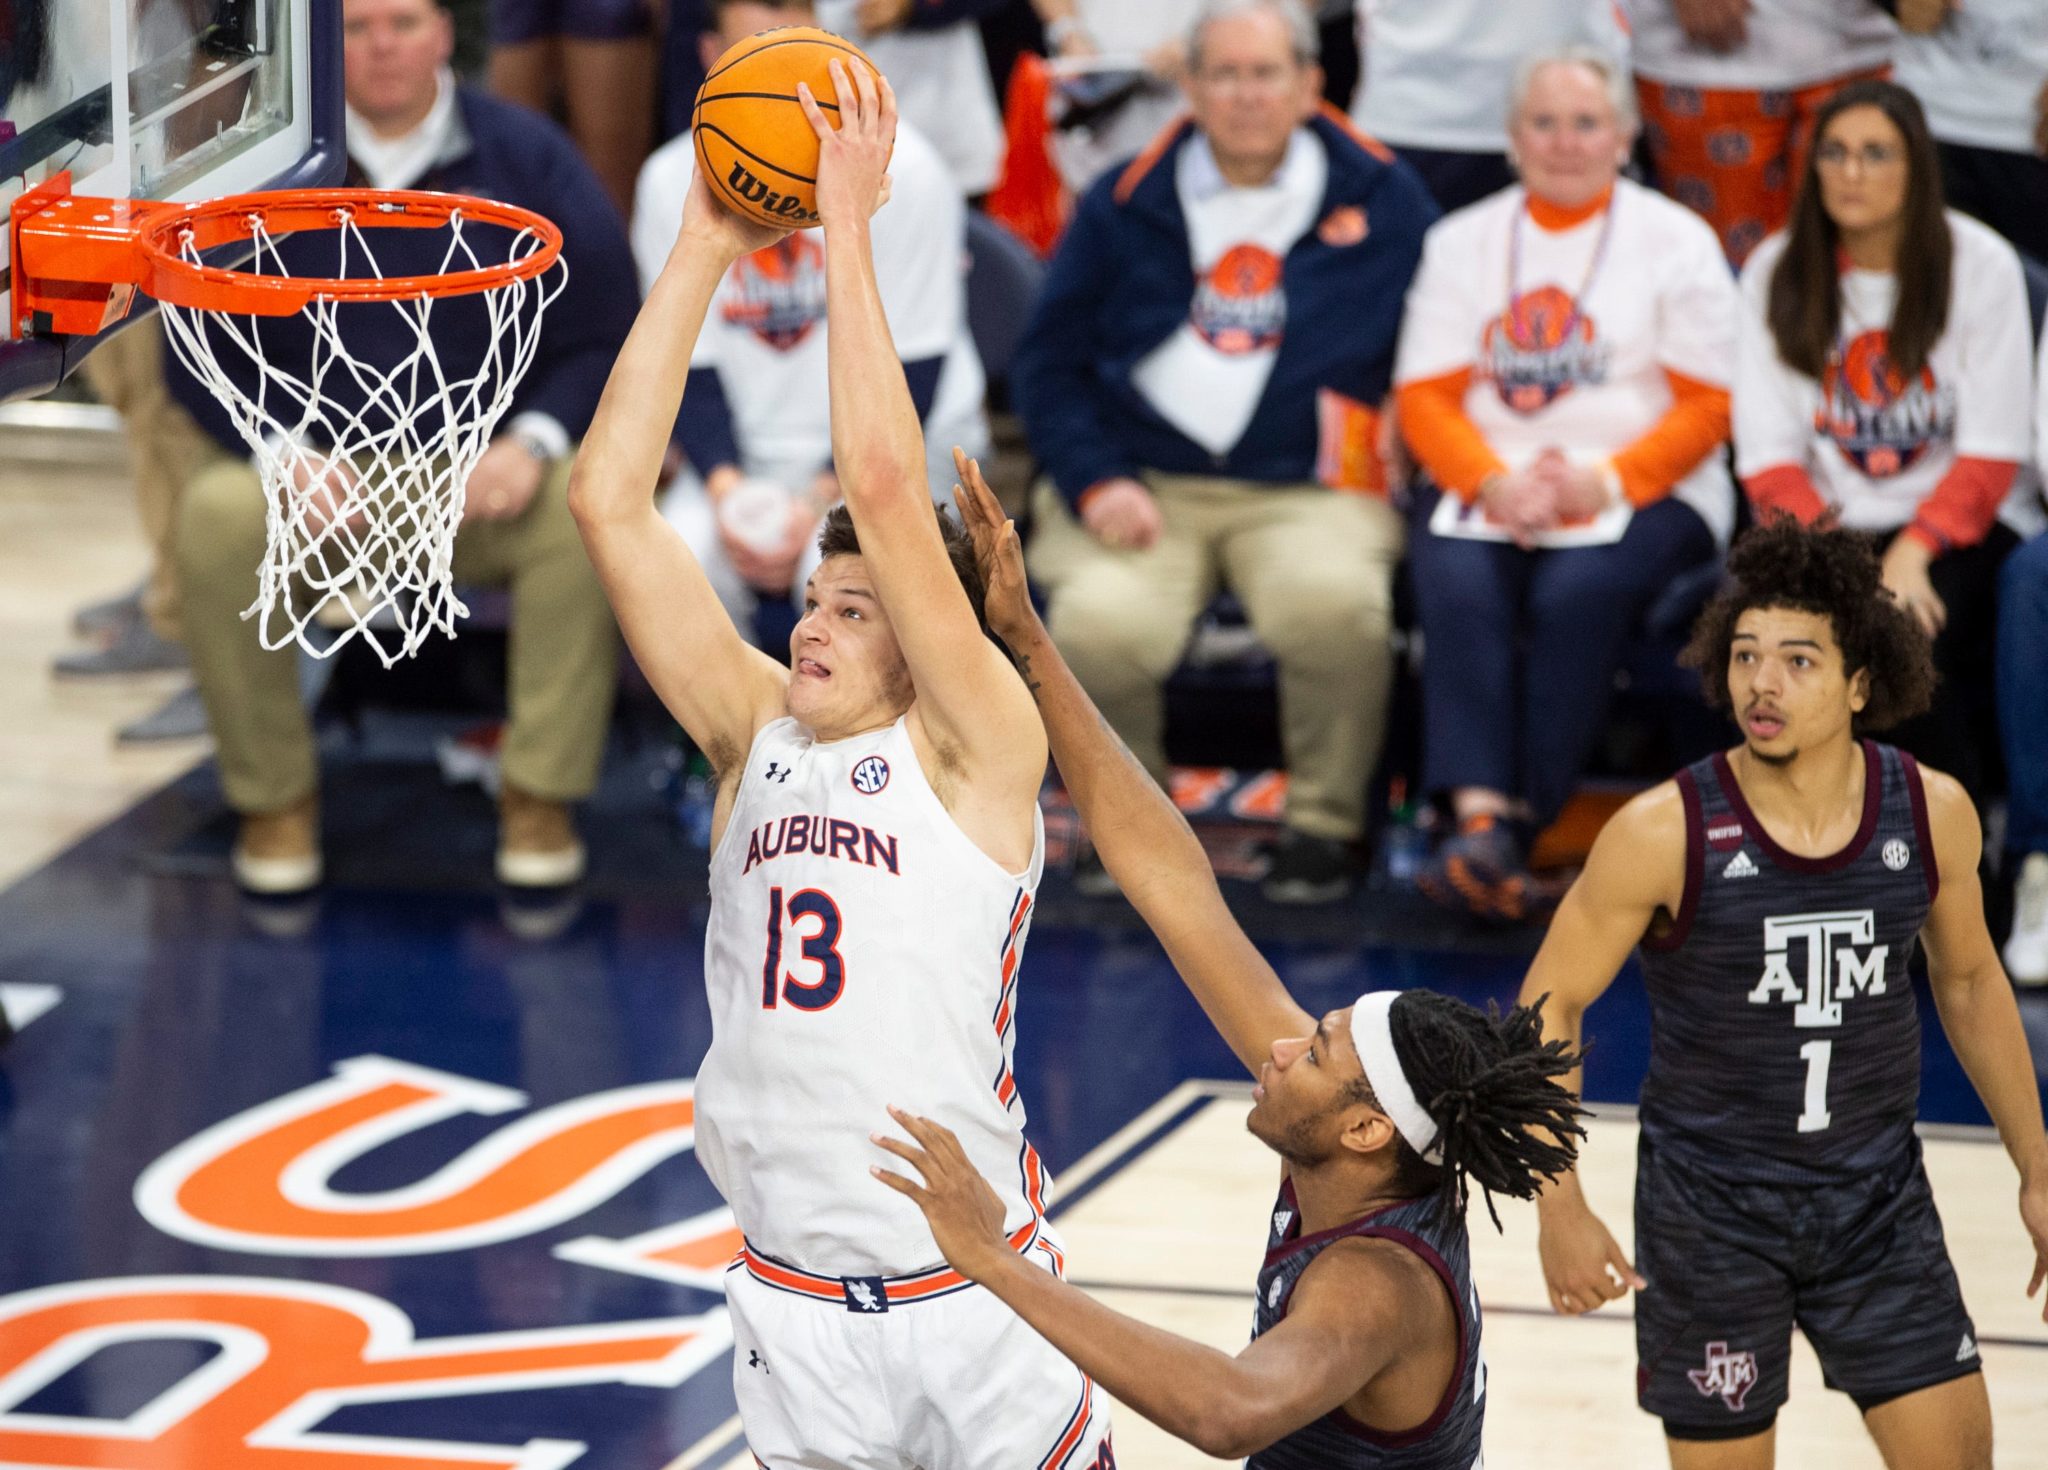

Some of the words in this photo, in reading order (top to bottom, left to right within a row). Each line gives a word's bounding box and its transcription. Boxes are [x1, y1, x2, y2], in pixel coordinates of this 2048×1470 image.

[853, 758, 887, 793] SEC
[742, 814, 901, 876] AUBURN
[1707, 824, 1743, 841] UNIFIED
[762, 886, 846, 1012] 13
[1797, 1039, 1833, 1133] 1
